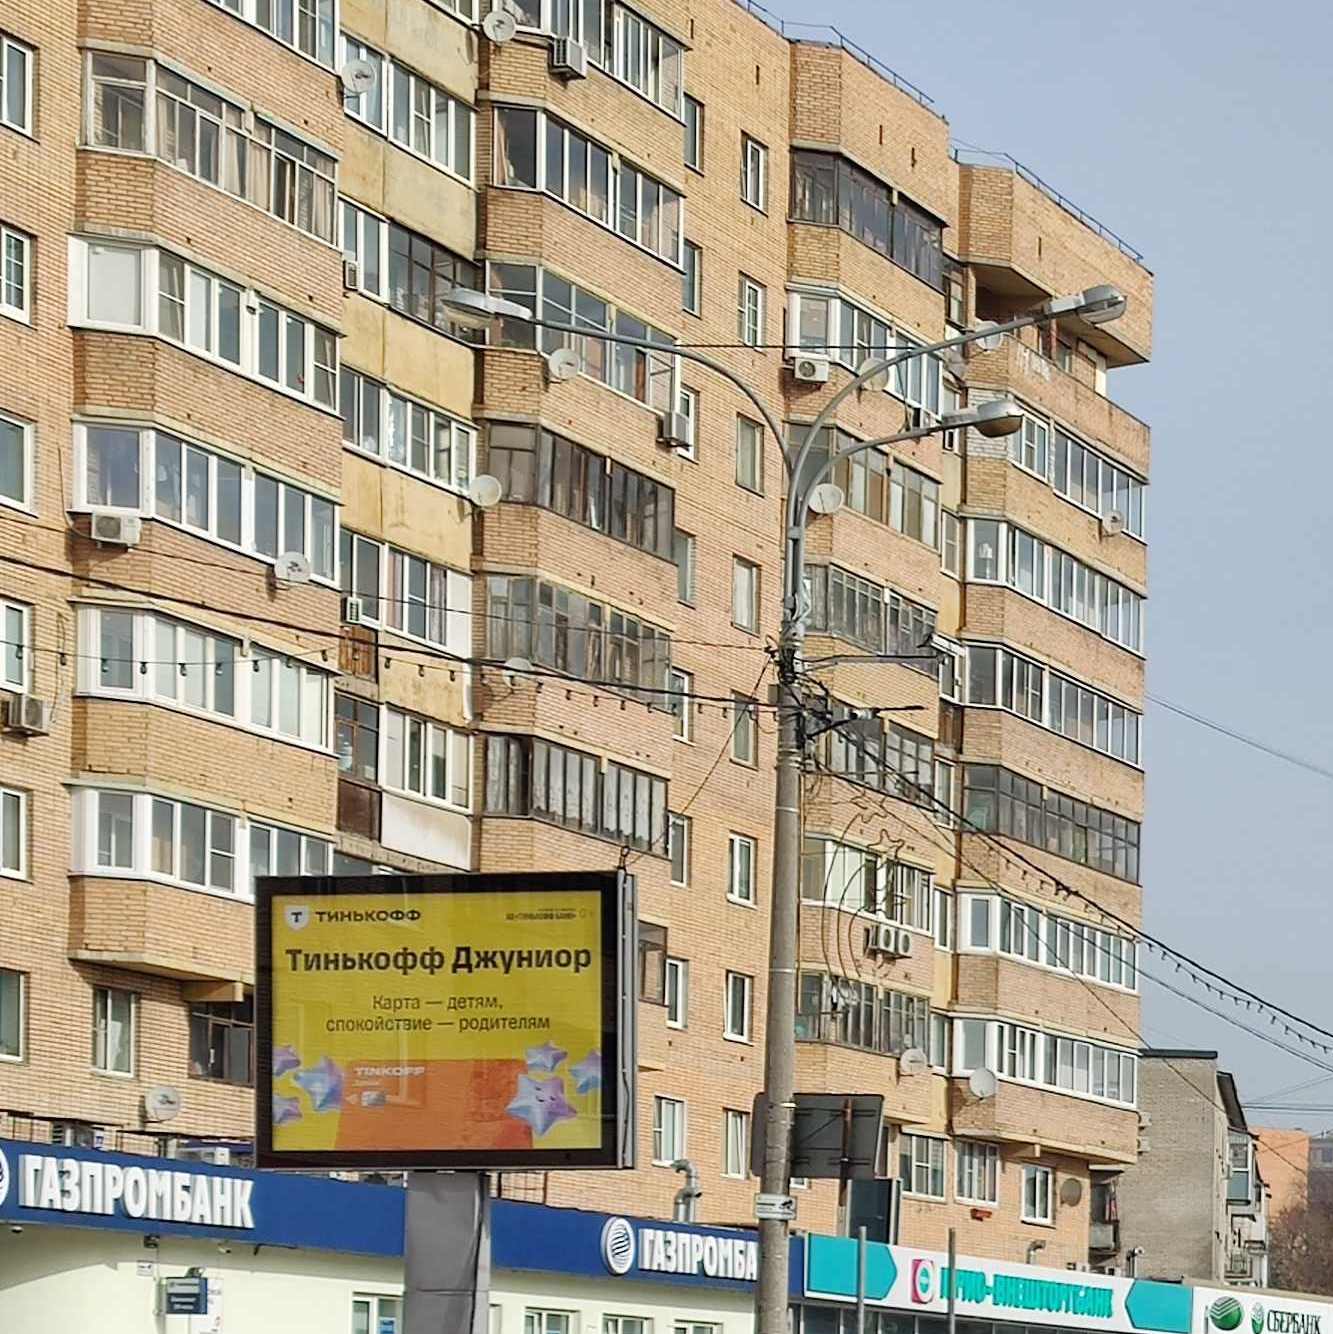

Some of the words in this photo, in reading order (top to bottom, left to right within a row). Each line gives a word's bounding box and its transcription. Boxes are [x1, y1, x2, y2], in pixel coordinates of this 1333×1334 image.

[315, 909, 421, 923] ТИНЬКОФФ
[285, 946, 445, 976] Тинькофф
[452, 946, 593, 974] Джуниор
[372, 995, 421, 1013] Карта
[447, 996, 504, 1011] детям,
[326, 1016, 433, 1032] спокойствие
[459, 1017, 551, 1032] родителям
[18, 1154, 256, 1229] ГАЗПРОМБАНК
[638, 1227, 758, 1282] ГАЗПРОМБА
